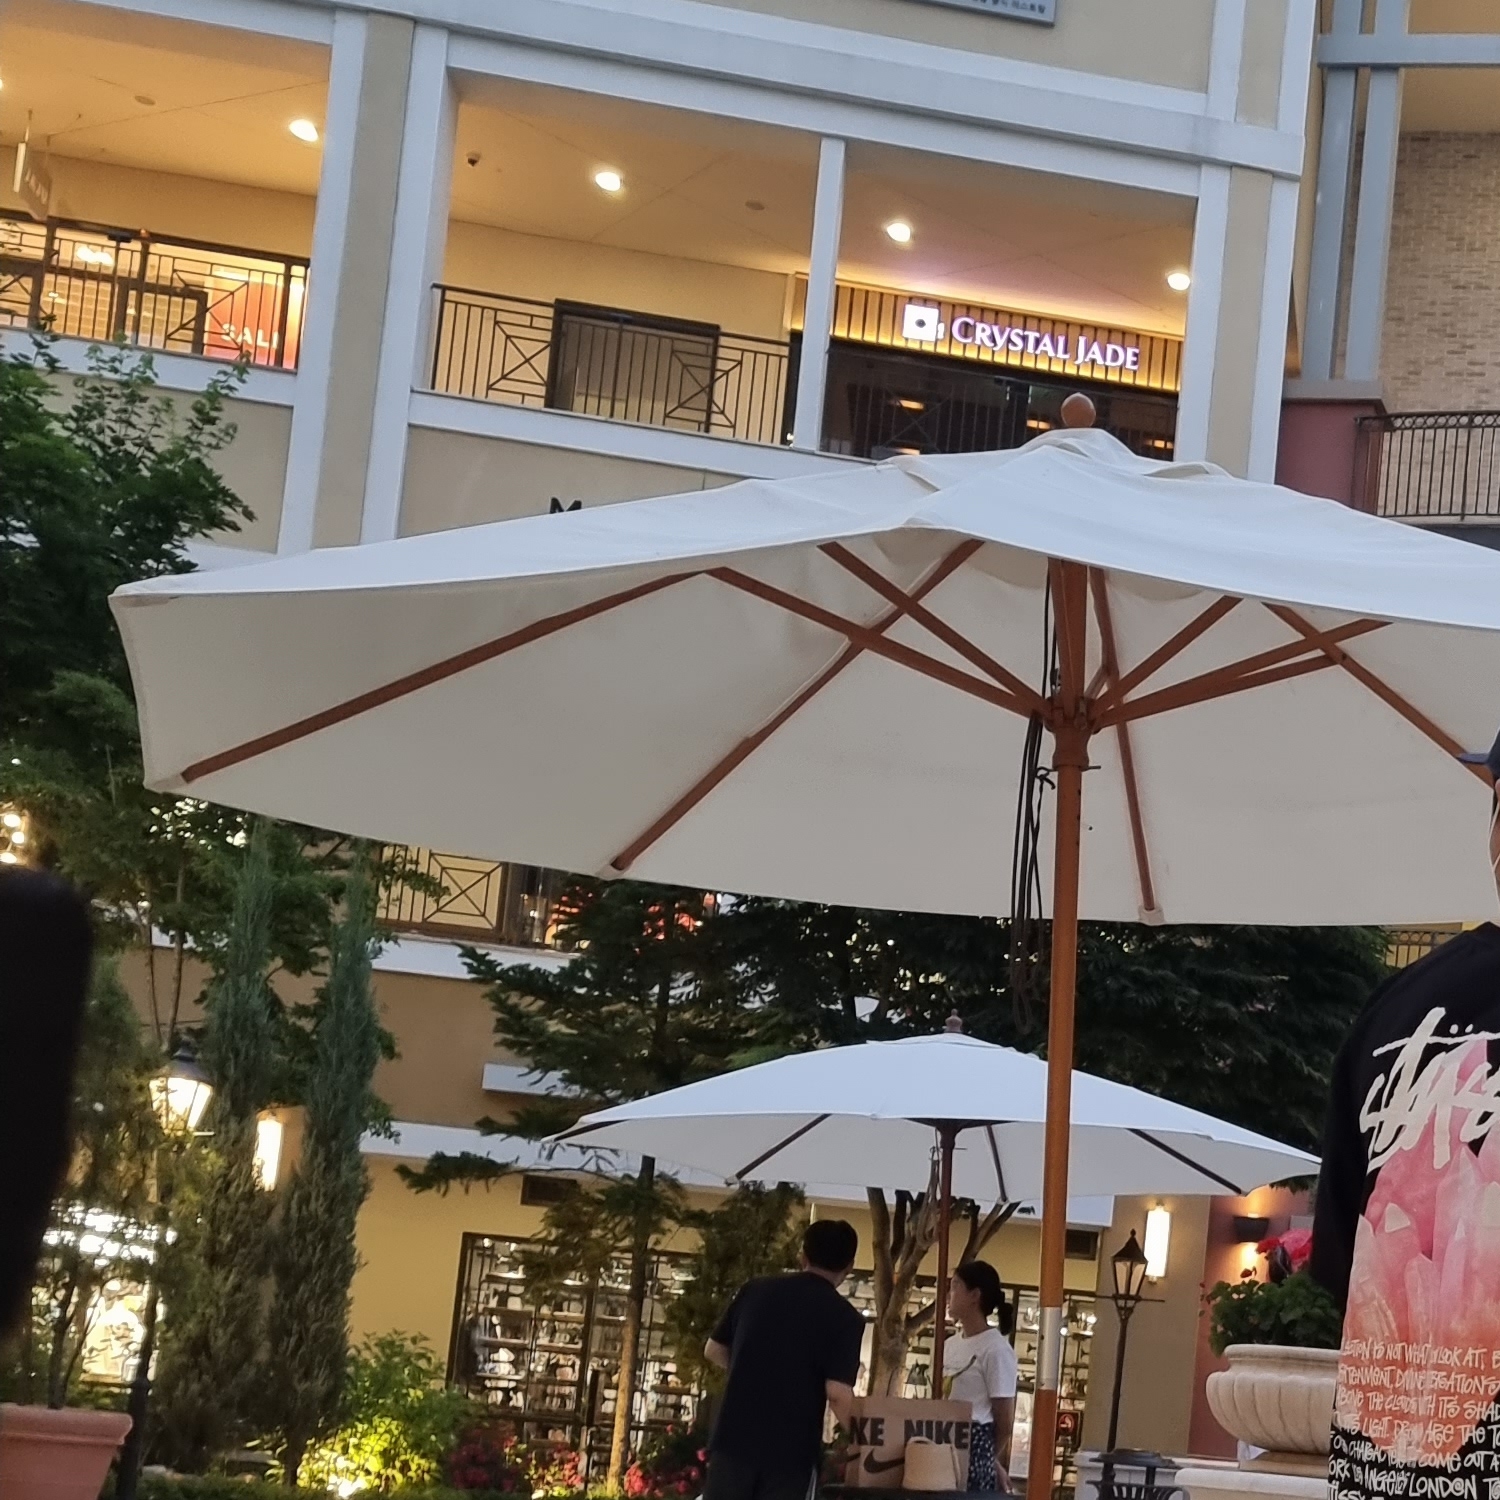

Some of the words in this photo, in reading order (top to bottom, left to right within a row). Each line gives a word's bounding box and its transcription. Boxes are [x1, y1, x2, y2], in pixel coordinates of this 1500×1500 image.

[952, 316, 1070, 359] CRYSTAL
[1074, 335, 1140, 371] JADE
[851, 1416, 885, 1446] KE
[904, 1419, 970, 1450] NIKE
